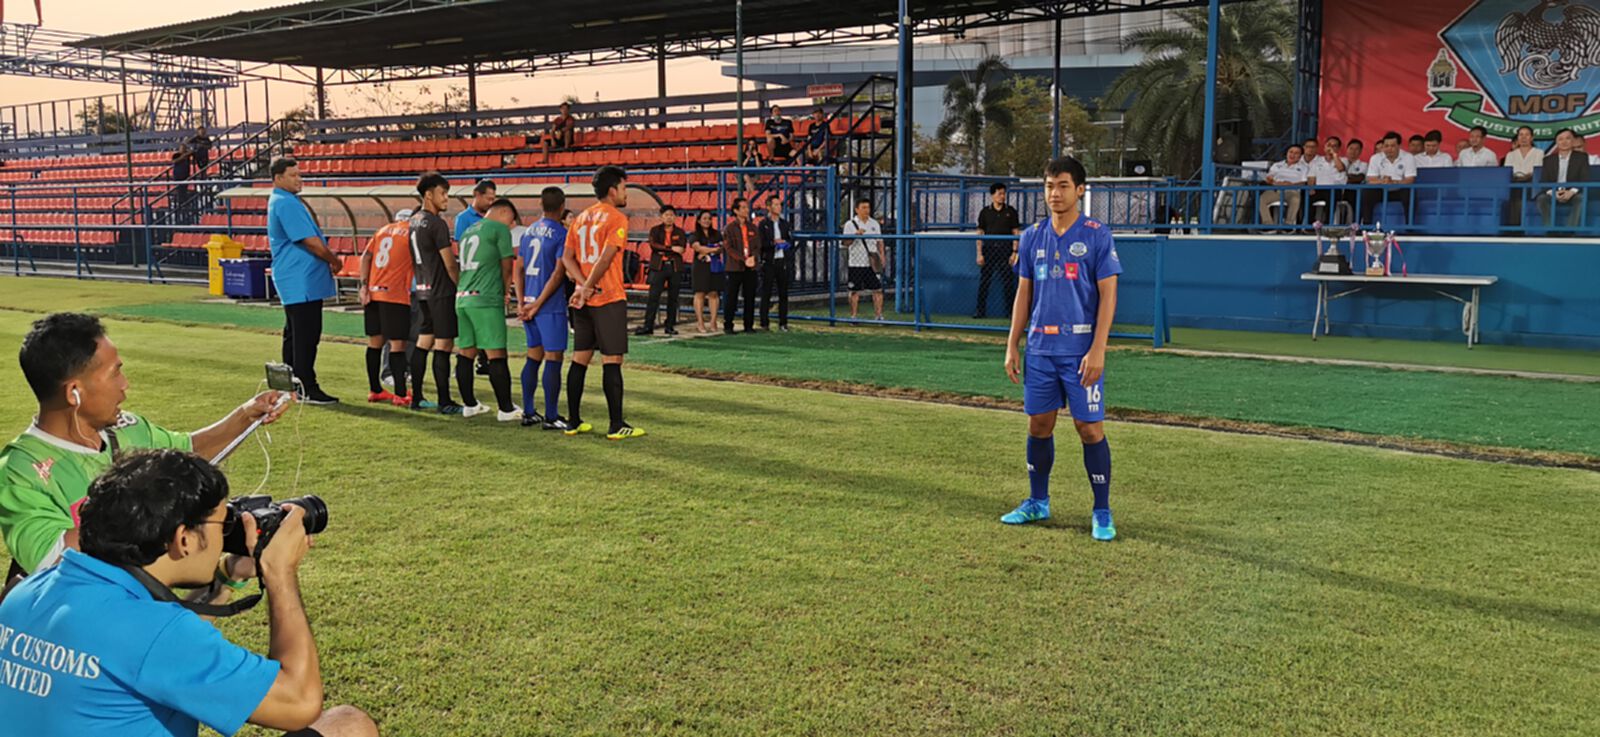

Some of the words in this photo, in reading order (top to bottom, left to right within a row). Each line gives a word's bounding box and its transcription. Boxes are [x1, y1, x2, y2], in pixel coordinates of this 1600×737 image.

[1509, 93, 1587, 114] MOF
[375, 237, 393, 269] 8
[411, 231, 422, 264] 1
[459, 235, 480, 272] 12
[526, 238, 541, 276] 2
[577, 225, 599, 263] 15
[1086, 384, 1101, 403] 16
[11, 632, 100, 679] CUSTOMS
[0, 657, 52, 697] NITED
